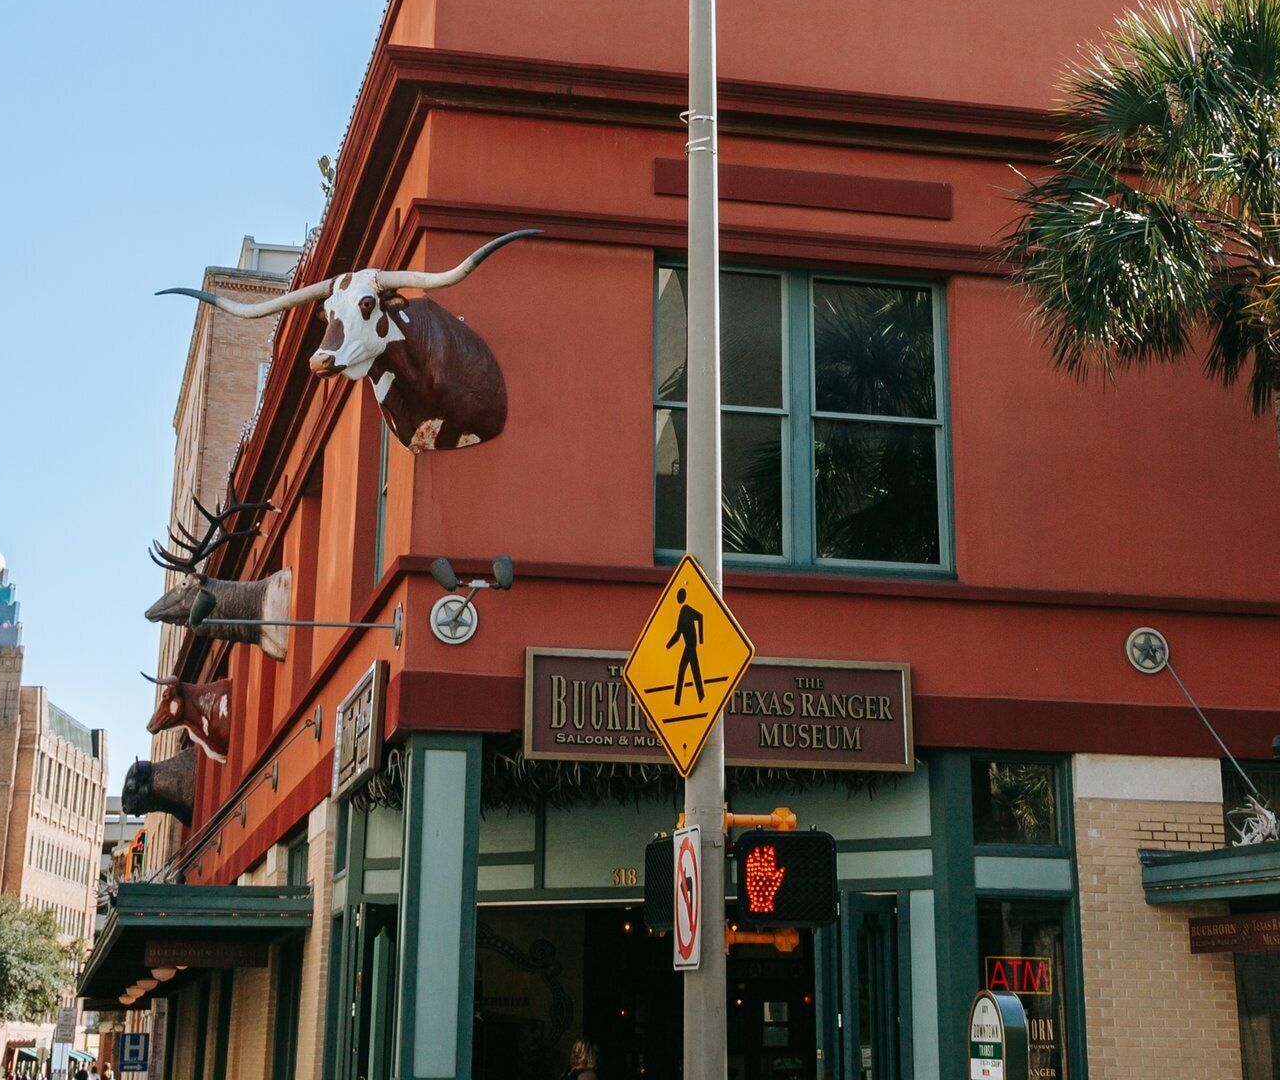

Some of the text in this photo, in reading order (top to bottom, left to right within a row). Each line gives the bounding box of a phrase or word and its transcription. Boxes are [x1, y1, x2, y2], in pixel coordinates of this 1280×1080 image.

[796, 677, 824, 689] THE
[729, 690, 893, 720] TEXAS RANGER
[556, 733, 613, 745] SALOON
[619, 735, 629, 745] &
[759, 723, 862, 749] MUSEUM
[612, 868, 637, 887] 318
[1191, 923, 1236, 936] BUCKHORN
[989, 960, 1049, 991] ATM
